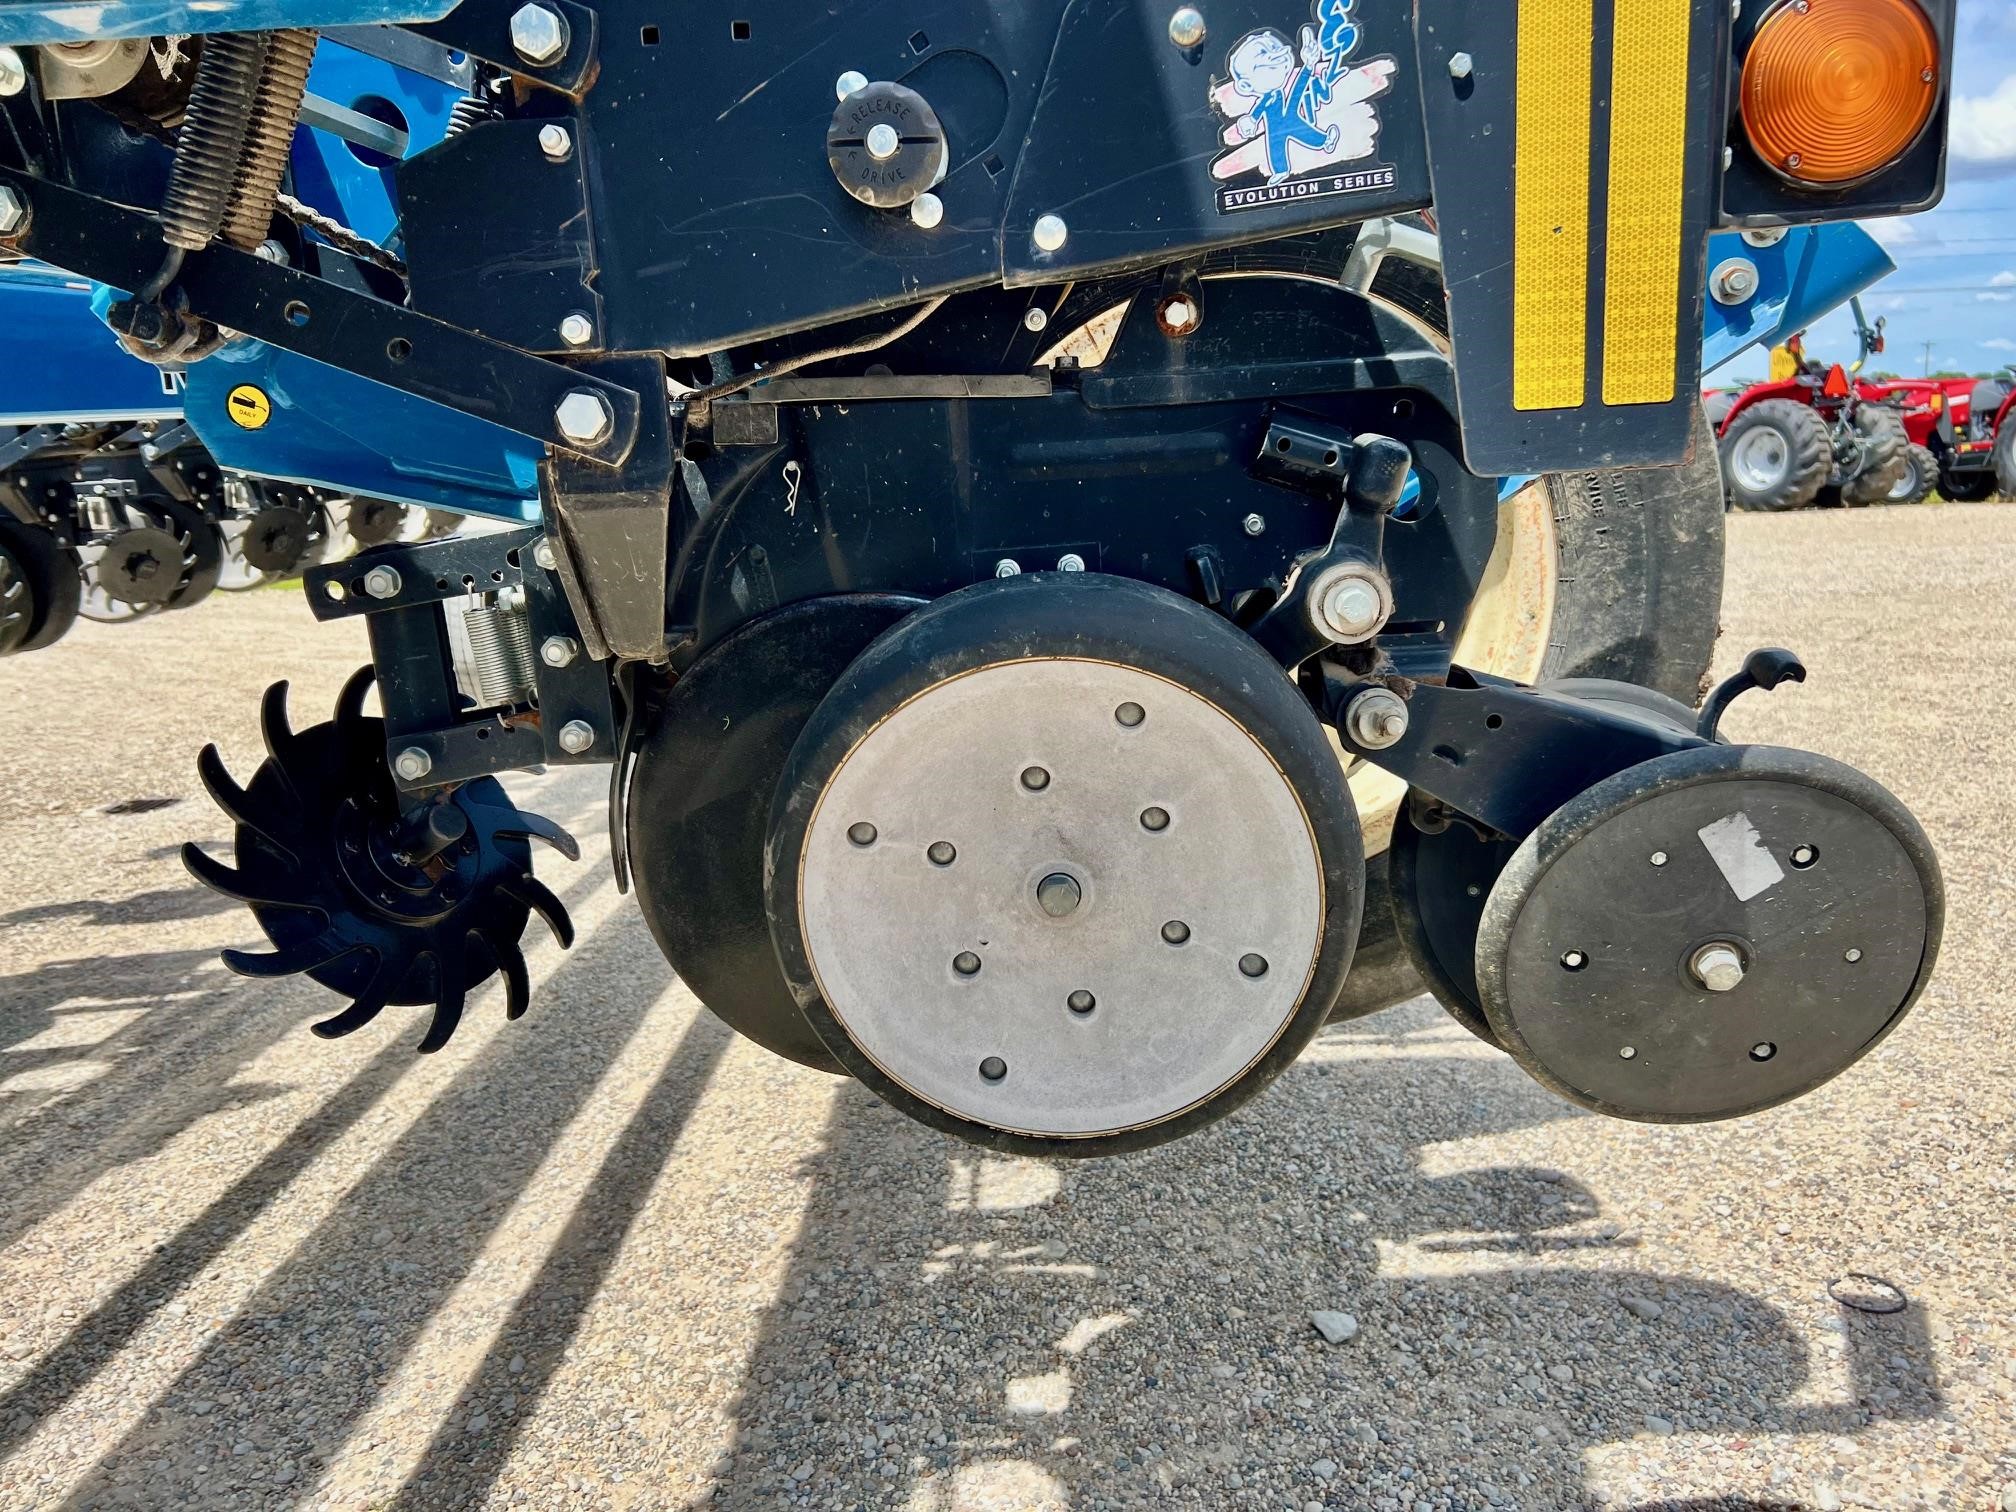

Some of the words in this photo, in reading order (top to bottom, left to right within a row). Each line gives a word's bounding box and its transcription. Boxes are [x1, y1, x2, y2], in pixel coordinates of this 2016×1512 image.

[851, 98, 911, 124] RELEASE
[861, 167, 906, 185] DRIVE
[1224, 182, 1320, 207] EVOLUTION
[1333, 172, 1394, 190] SERIES
[239, 409, 256, 418] DAILY
